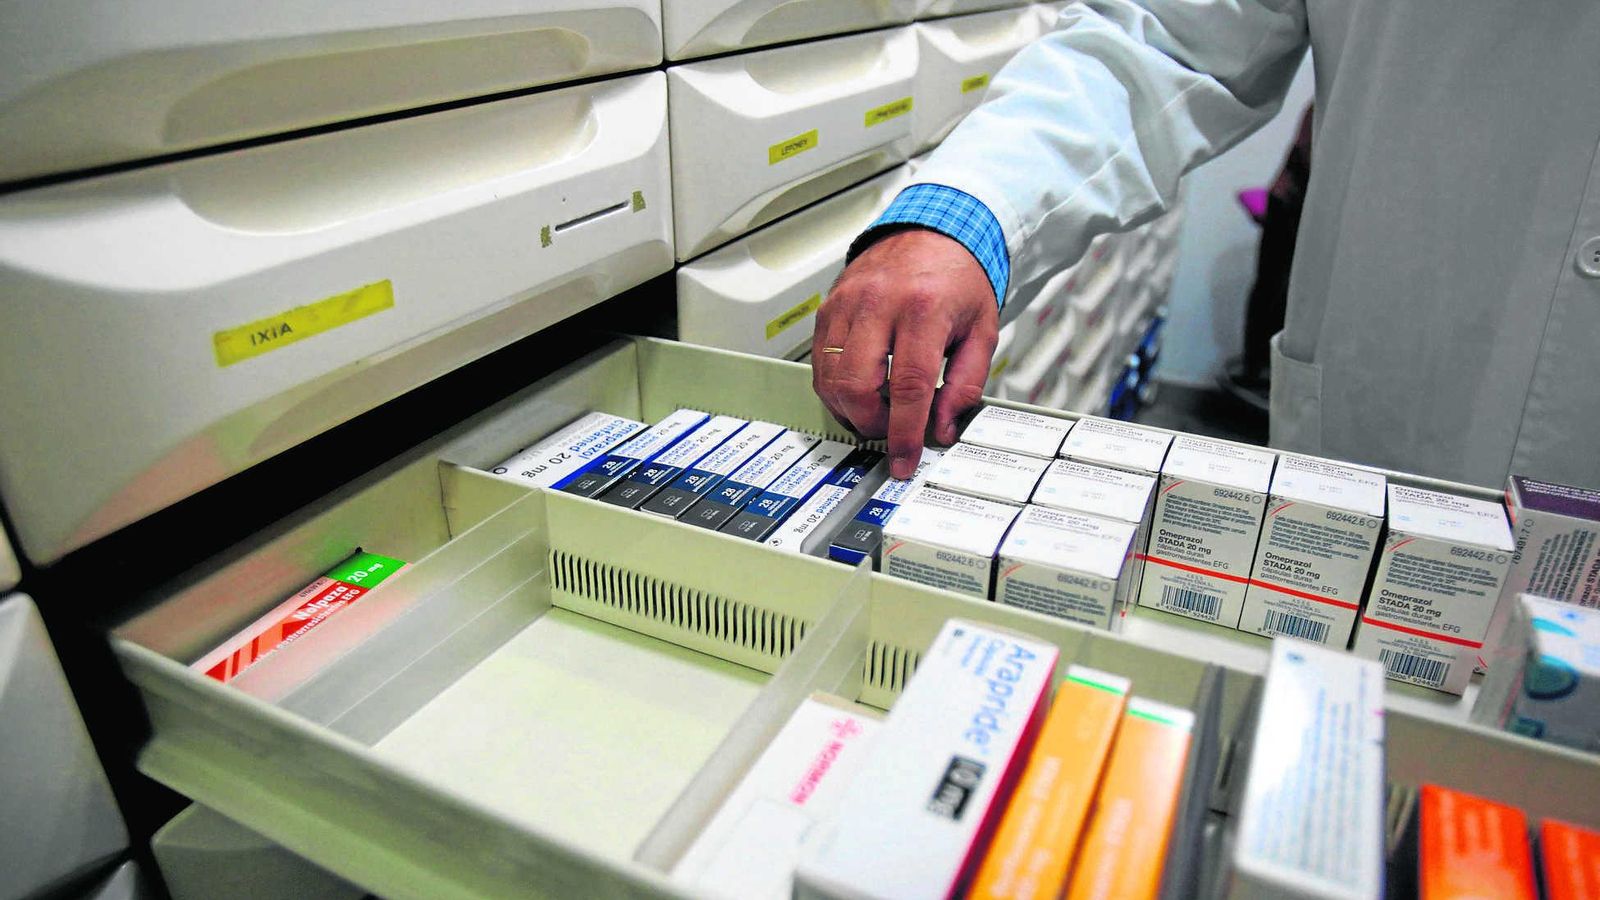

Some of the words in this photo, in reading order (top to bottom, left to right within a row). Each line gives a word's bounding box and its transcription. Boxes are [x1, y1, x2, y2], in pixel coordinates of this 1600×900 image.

[250, 322, 294, 346] IXIA
[569, 419, 625, 454] cinfamed
[578, 423, 639, 460] omeprazol
[736, 441, 749, 450] 20
[549, 452, 572, 465] 20
[771, 452, 783, 461] 20
[521, 464, 548, 479] mg
[602, 461, 617, 470] 28
[806, 462, 820, 471] 20
[644, 468, 659, 477] 28
[685, 475, 699, 484] 28
[721, 487, 736, 497] 28
[1213, 488, 1250, 502] 692442.6
[759, 499, 774, 509] 28
[806, 514, 821, 523] 20
[868, 507, 884, 517] 28
[1326, 510, 1366, 527] 692442.6
[1160, 528, 1203, 545] Omeprazol
[1158, 536, 1186, 548] STADA
[1186, 542, 1198, 551] 20
[1198, 546, 1212, 556] mg
[1186, 550, 1204, 558] duras
[1265, 552, 1312, 569] Omeprazol
[1450, 546, 1494, 562] 692442.6
[1212, 560, 1228, 570] EFG
[1262, 559, 1293, 573] STADA
[1294, 566, 1305, 575] 20
[1306, 570, 1321, 580] mg
[347, 570, 369, 583] 20
[368, 563, 384, 572] mg
[1292, 574, 1313, 583] duras
[341, 588, 361, 602] EFG
[1320, 586, 1338, 595] EFG
[1380, 588, 1432, 606] Omeprazol
[292, 584, 349, 621] Nolpaza
[1378, 596, 1410, 610] STADA
[1412, 604, 1424, 613] 20
[1426, 608, 1442, 618] mg
[1411, 611, 1432, 621] duras
[1442, 623, 1461, 634] EFG
[964, 643, 1036, 746] Arapride
